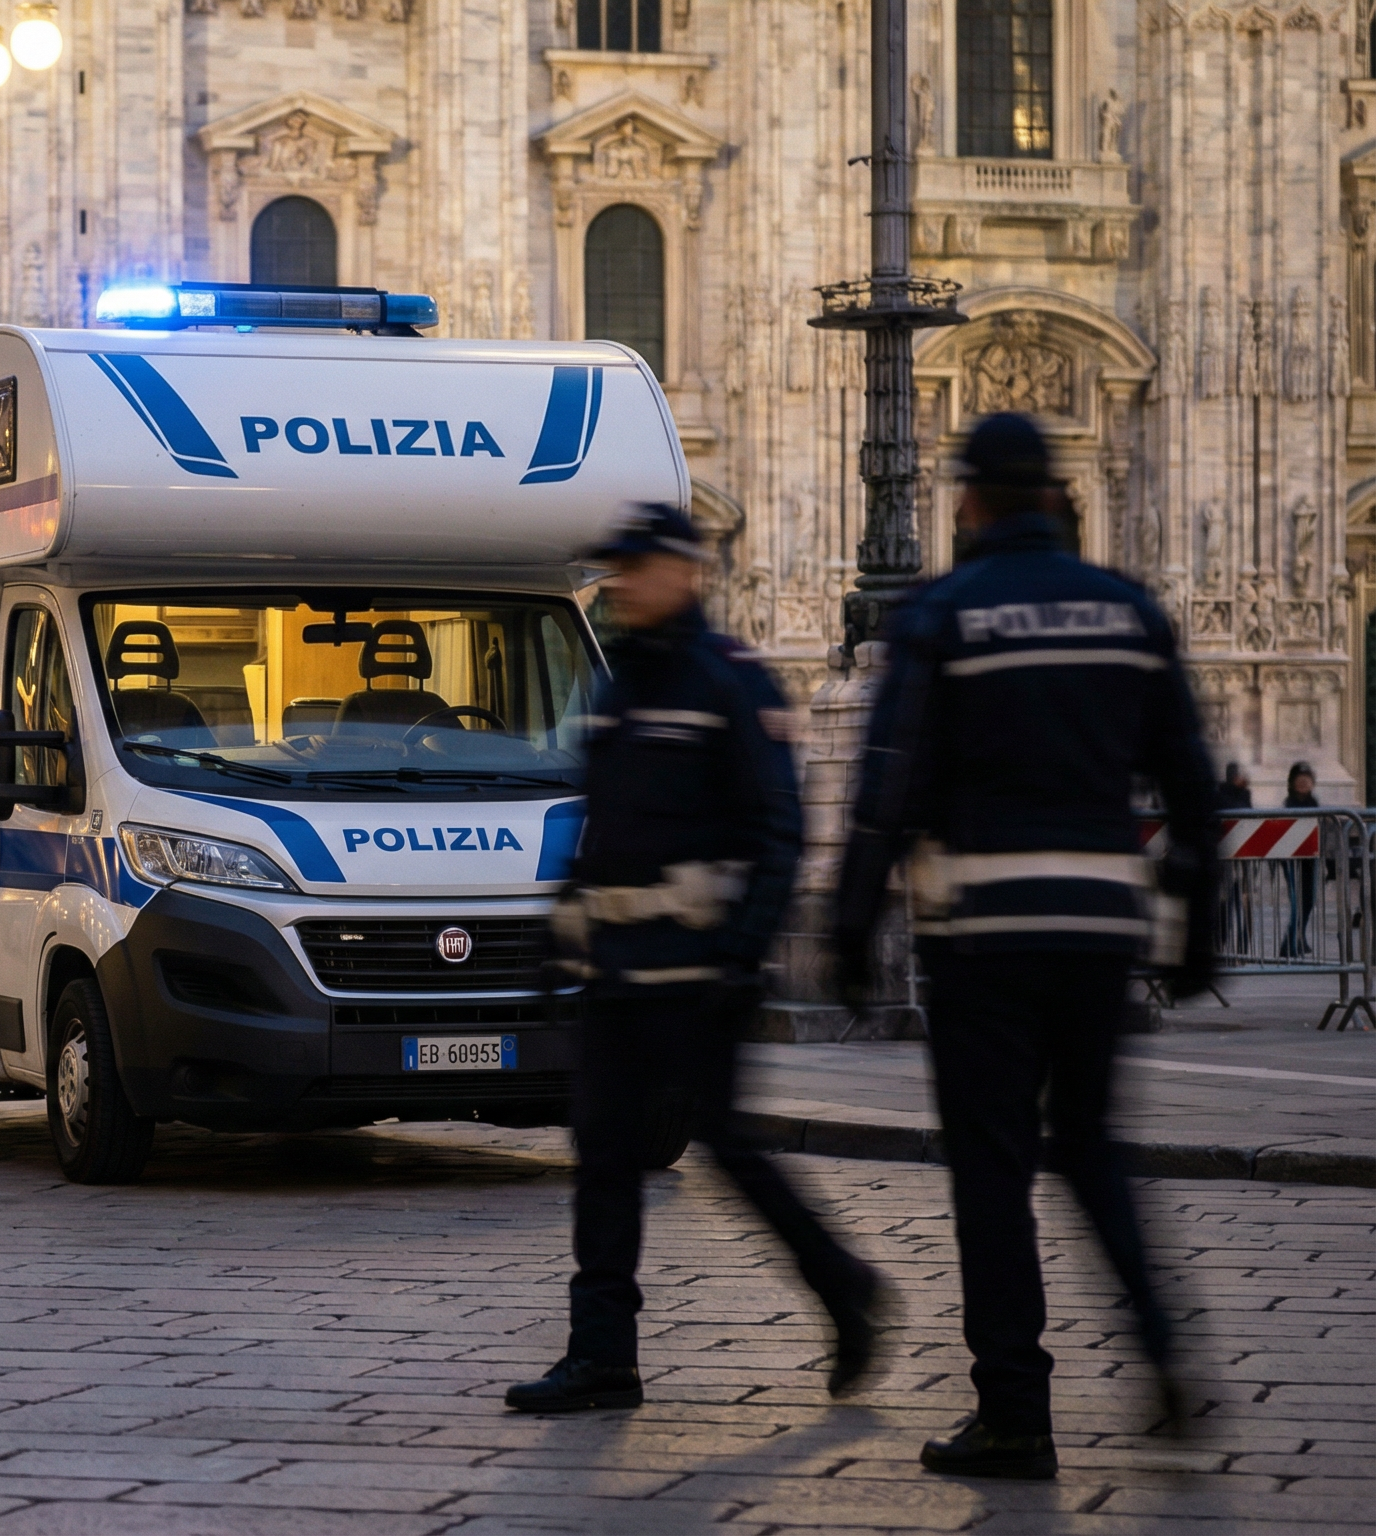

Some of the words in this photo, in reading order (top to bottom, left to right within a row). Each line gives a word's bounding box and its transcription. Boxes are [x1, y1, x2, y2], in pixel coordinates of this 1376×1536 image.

[240, 416, 505, 457] POLIZIA
[342, 827, 524, 852] POLIZIA
[420, 1044, 439, 1064] EB
